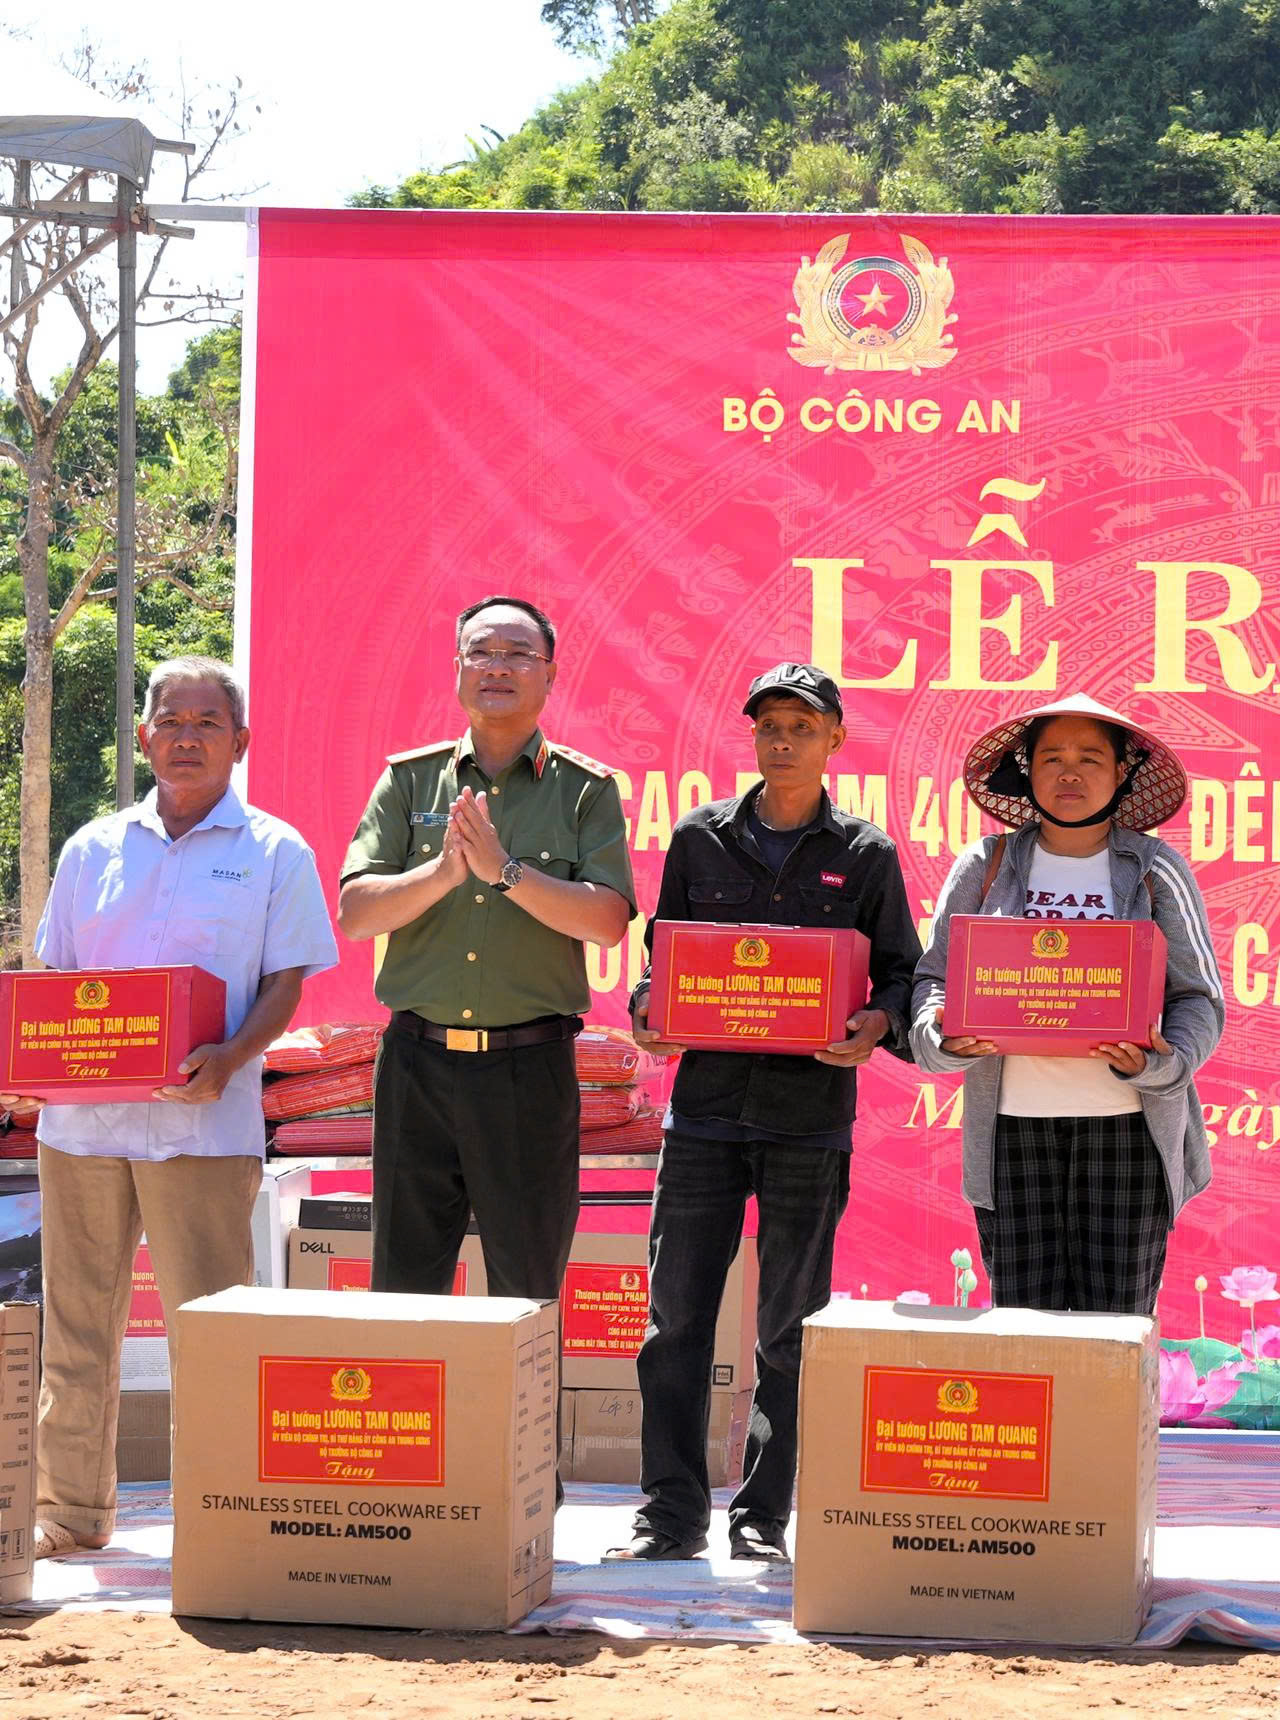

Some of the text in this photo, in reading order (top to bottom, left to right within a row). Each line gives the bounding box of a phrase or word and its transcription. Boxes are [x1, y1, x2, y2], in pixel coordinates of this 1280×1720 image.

[722, 388, 1021, 442] BỘ CÔNG AN
[791, 477, 1060, 692] LỄ
[1026, 890, 1106, 908] BEAR
[679, 975, 694, 993] Đại
[726, 974, 760, 992] LƯƠNG
[763, 976, 784, 992] TAM
[787, 978, 821, 994] QUANG
[976, 967, 991, 986] Đại
[1024, 965, 1059, 983] LƯƠNG
[1062, 968, 1083, 984] TAM
[1087, 968, 1122, 984] QUANG
[22, 1022, 36, 1039] Đại
[68, 1017, 101, 1035] LƯƠNG
[104, 1017, 124, 1033] TAM
[127, 1016, 159, 1033] QUANG
[724, 1021, 769, 1036] Tặng
[1023, 1013, 1069, 1027] Tặng
[66, 1064, 109, 1080] Tặng
[300, 1242, 334, 1253] DELL
[132, 1272, 155, 1282] hượng
[599, 1396, 622, 1416] Lớp
[273, 1410, 289, 1430] Đại
[324, 1408, 362, 1428] LƯƠNG
[365, 1411, 388, 1429] TAM
[392, 1412, 431, 1431] QUANG
[877, 1420, 893, 1440] Đại
[929, 1420, 967, 1441] LƯƠNG
[971, 1424, 994, 1442] TAM
[998, 1426, 1036, 1445] QUANG
[325, 1462, 376, 1479] Tặng
[929, 1473, 980, 1491] Tặng
[202, 1495, 481, 1520] STAINLESS STEEL COOKWARE SET
[271, 1521, 411, 1540] MODEL: AM500
[823, 1510, 1106, 1537] STAINLESS STEEL COOKWARE SET
[893, 1536, 1035, 1556] MODEL: AM500
[288, 1571, 392, 1586] MADE IN VIETNAM
[910, 1585, 1015, 1601] MADE IN VIETNAM
